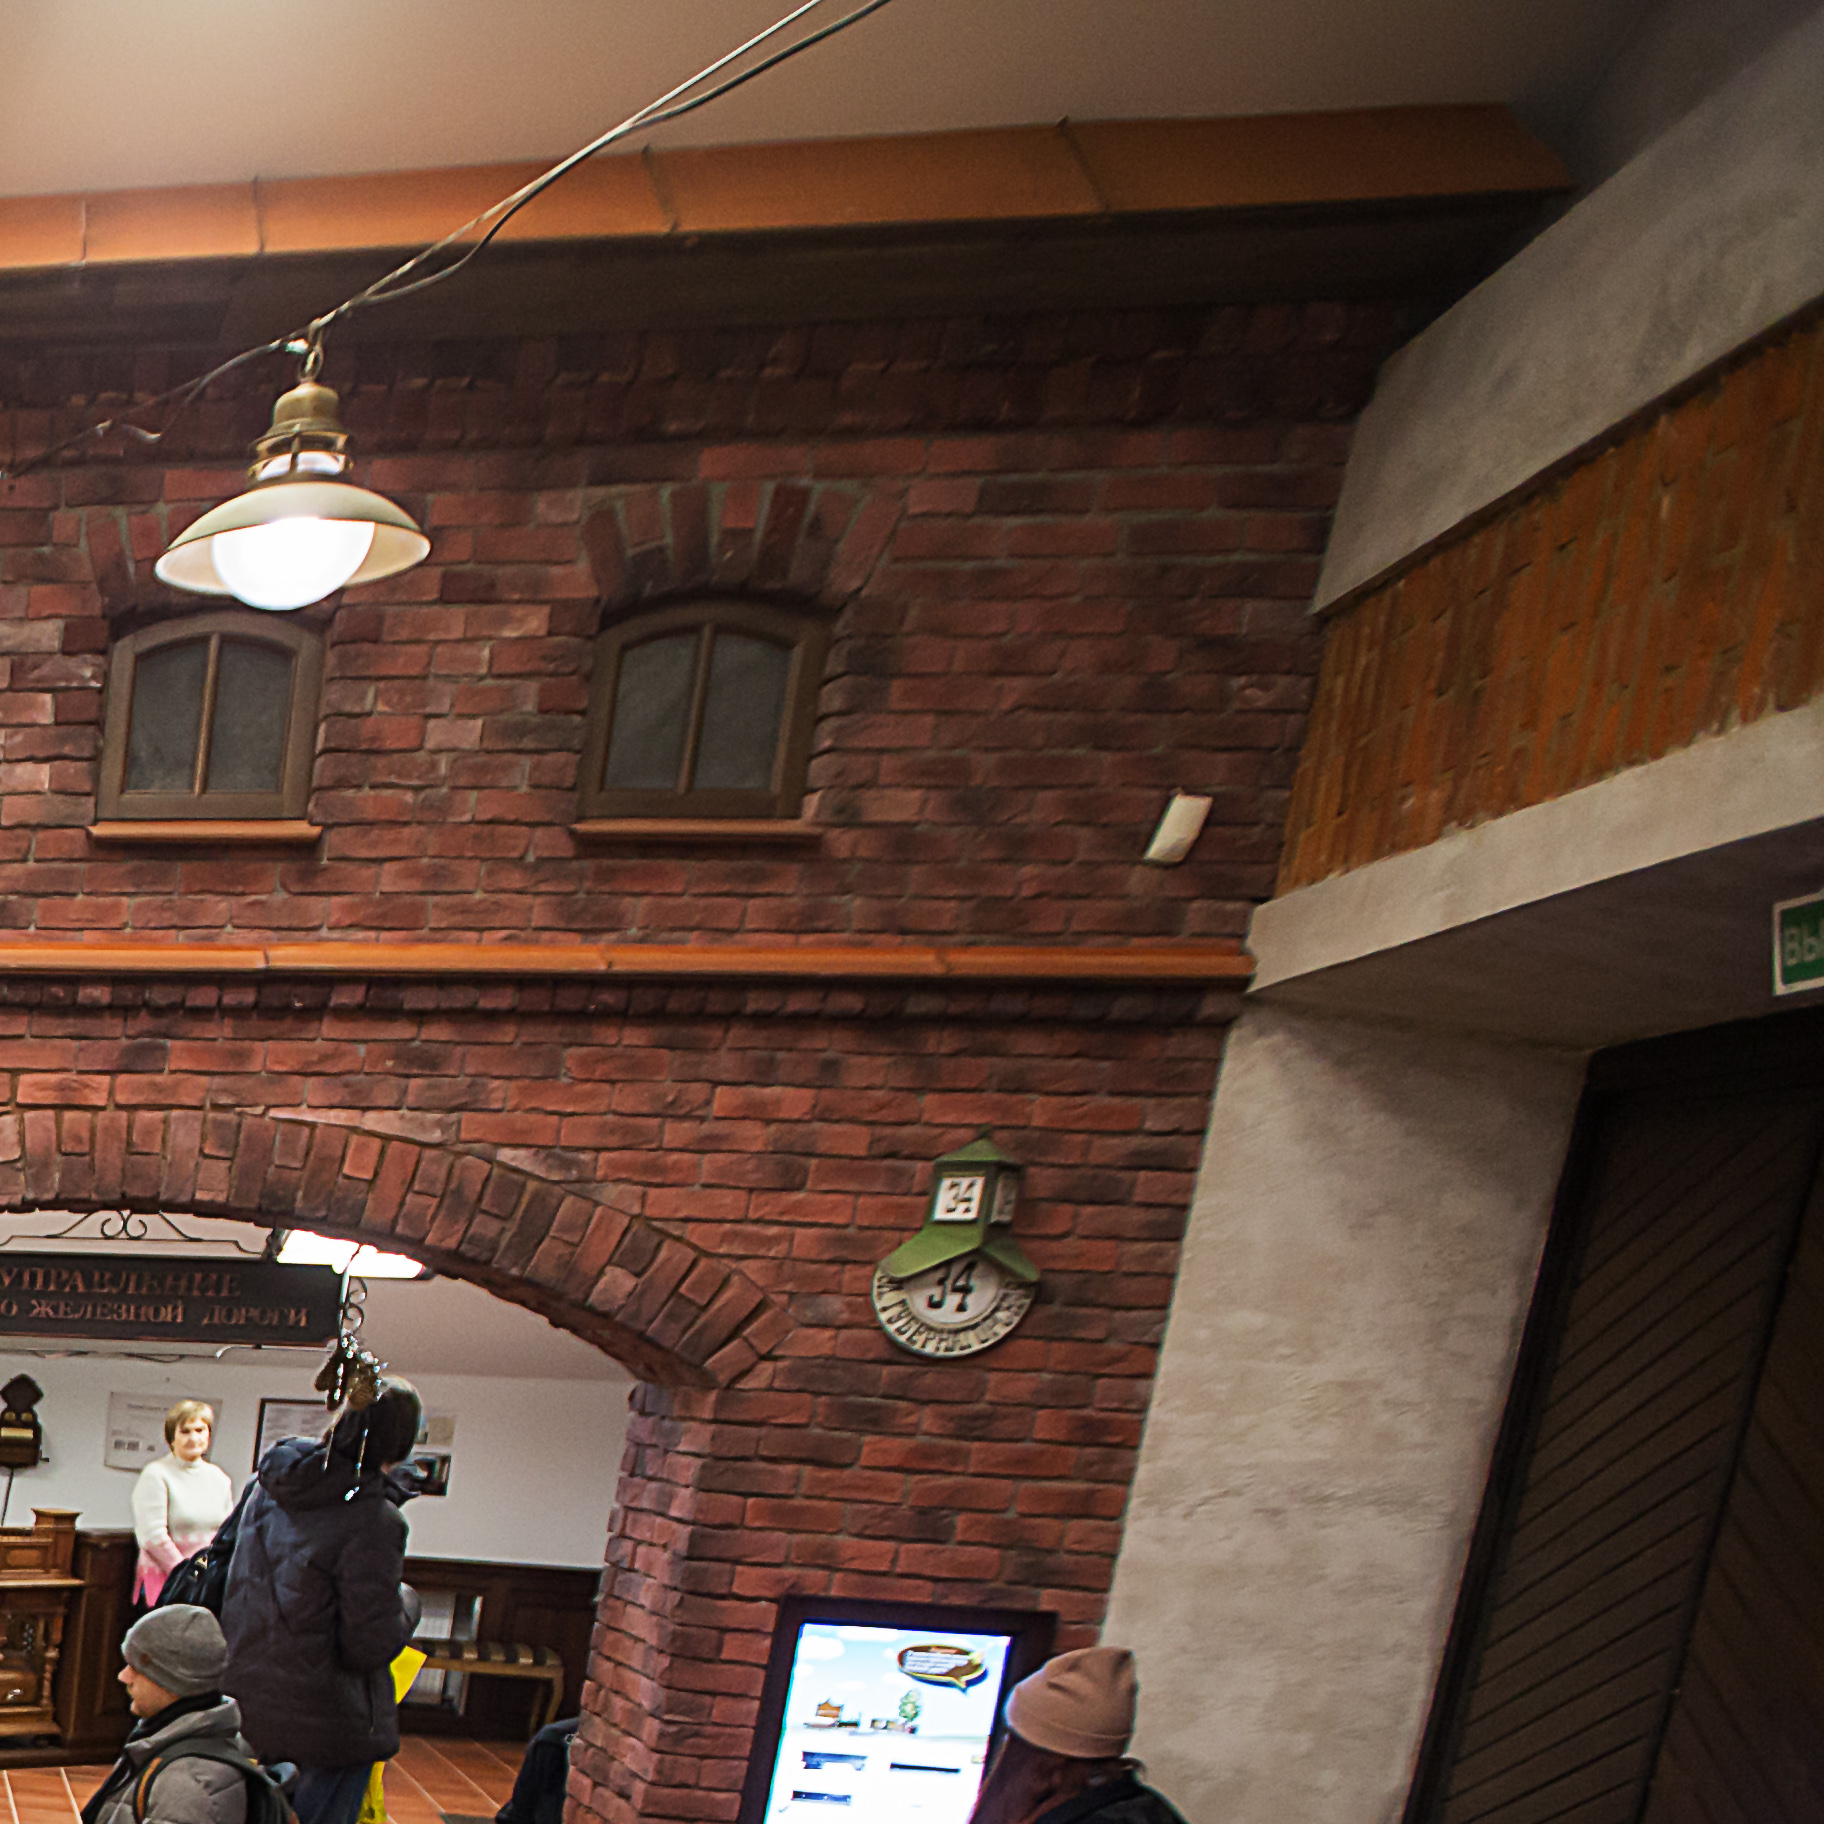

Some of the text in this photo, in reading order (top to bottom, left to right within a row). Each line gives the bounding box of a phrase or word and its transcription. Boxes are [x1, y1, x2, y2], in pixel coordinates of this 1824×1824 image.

[946, 1179, 977, 1214] 34
[926, 1258, 980, 1312] 34
[28, 1299, 185, 1324] ЖЕЛЕЗНОЙ
[202, 1305, 309, 1328] ДОРОГИ
